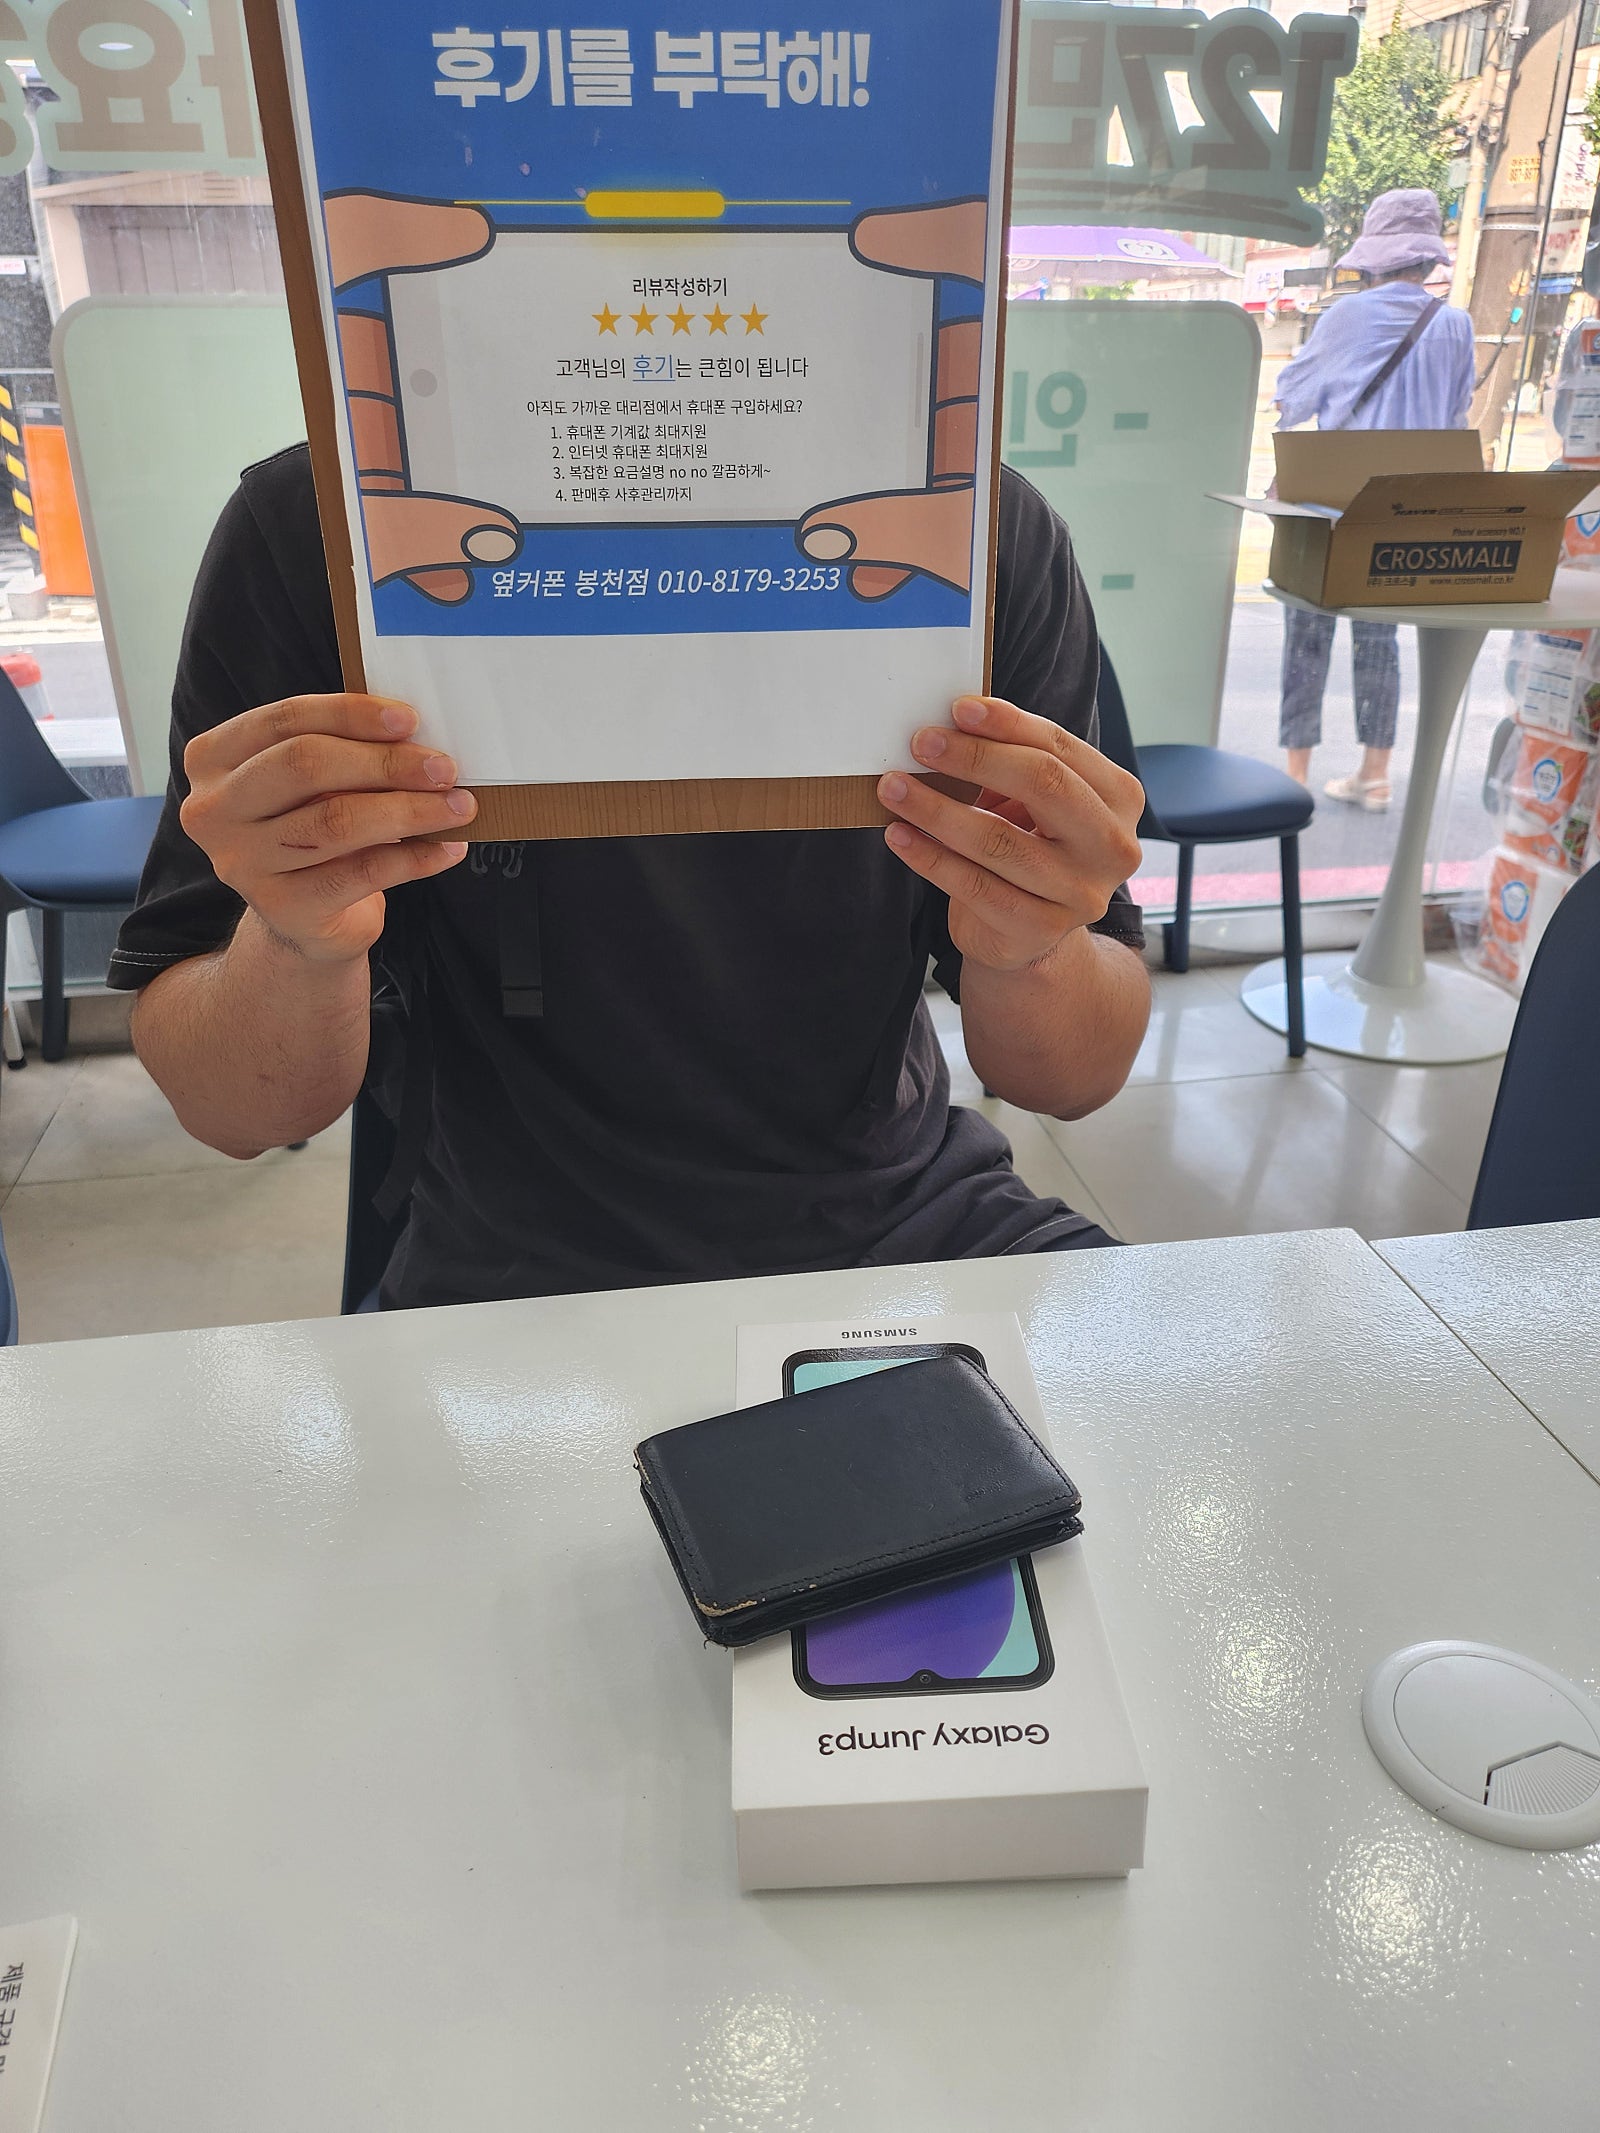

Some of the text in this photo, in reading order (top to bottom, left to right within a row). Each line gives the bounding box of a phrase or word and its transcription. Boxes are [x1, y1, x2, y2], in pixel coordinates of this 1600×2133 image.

[432, 27, 870, 108] 후기를 부탁해!
[632, 277, 728, 297] 리뷰작성하기
[556, 354, 809, 379] 고객님의 후기는 큰힘이 됩니다
[527, 399, 803, 416] 아직도 가까운 대리점에서 휴대폰 구입하세요?
[551, 424, 706, 439] 1. 휴대폰 기계값 최대지원
[552, 444, 708, 459] 2. 인터넷 휴대폰 최대지원
[553, 464, 771, 480] 3. 복잡한 요금설명 no no 깔끔하게~
[555, 487, 692, 501] 4. 판매후 사후관리까지
[1375, 546, 1513, 570] CROSSMALL
[491, 567, 841, 597] 옆커폰 봉천점 010-8179-3253
[841, 1327, 917, 1339] SAMSUNG
[818, 1722, 1050, 1756] Galaxy Jump3
